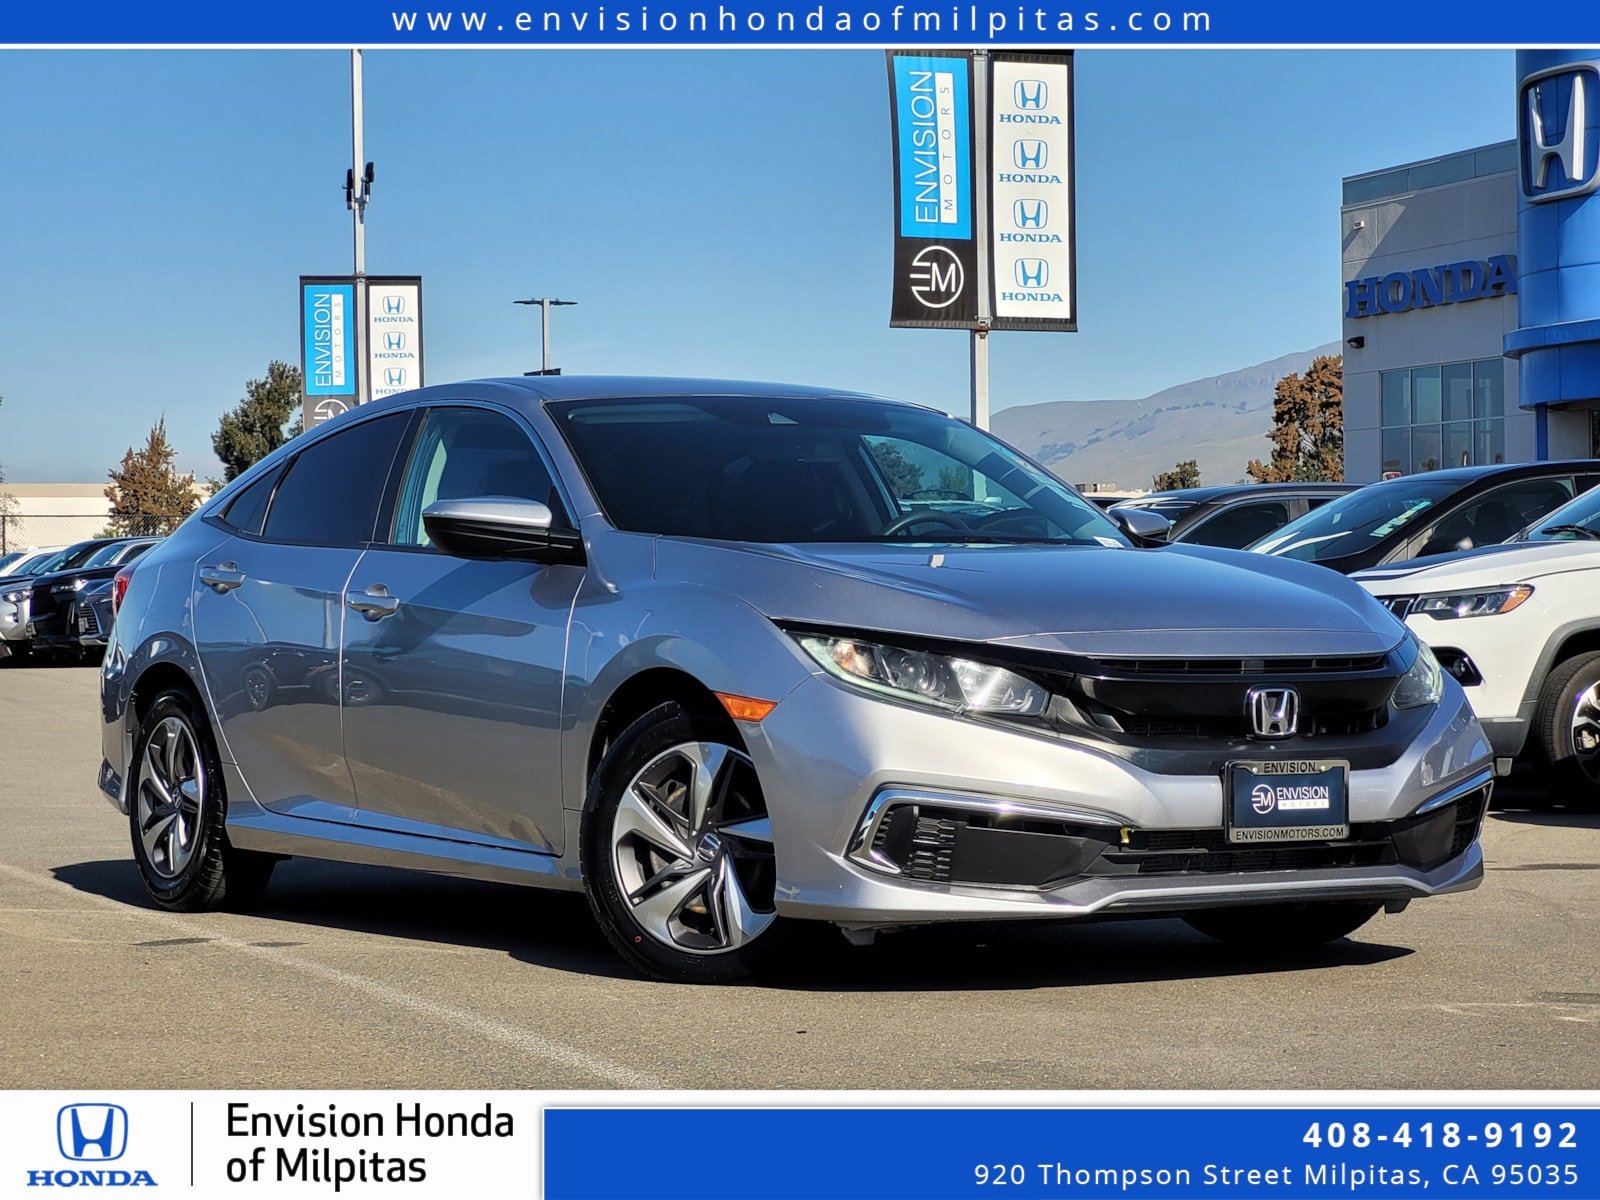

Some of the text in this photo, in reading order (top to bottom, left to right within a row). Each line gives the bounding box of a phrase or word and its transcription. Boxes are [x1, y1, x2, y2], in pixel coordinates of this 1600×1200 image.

[1000, 114, 1062, 125] HONDA
[910, 71, 939, 224] ENVISION
[940, 86, 955, 211] MOTORS
[1000, 173, 1062, 184] HONDA
[1000, 232, 1063, 243] HONDA
[1345, 255, 1517, 318] HONDA
[1001, 292, 1064, 302] HONDA
[314, 293, 332, 387] ENVISION
[1264, 762, 1315, 773] ENVISION
[1277, 786, 1329, 800] ENVISION
[1236, 828, 1344, 840] ENVISIONMOTORS.COM
